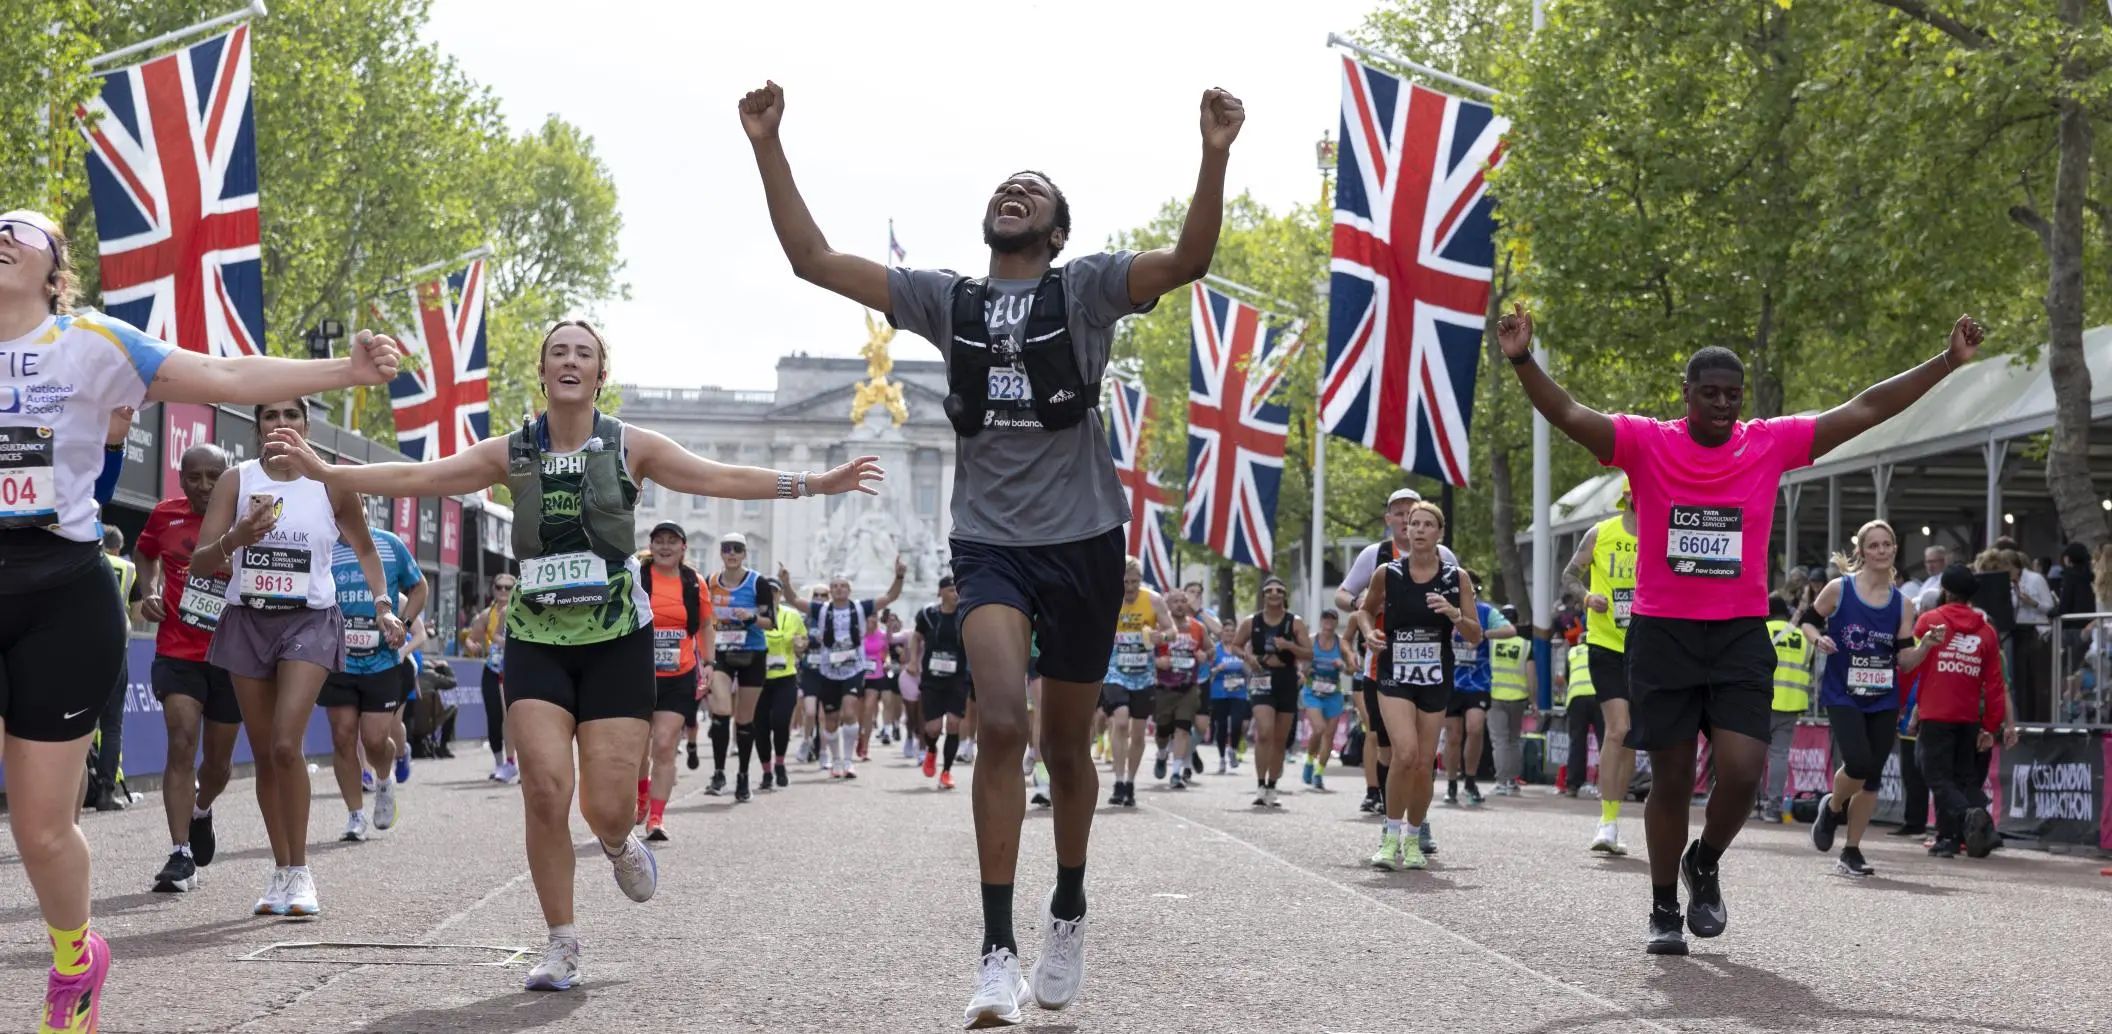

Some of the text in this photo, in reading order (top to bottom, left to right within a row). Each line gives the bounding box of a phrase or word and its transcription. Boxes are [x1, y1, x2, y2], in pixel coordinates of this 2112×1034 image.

[25, 384, 73, 393] National
[26, 394, 69, 403] Autistic
[26, 404, 65, 415] Society
[994, 419, 1011, 427] new
[1674, 508, 1700, 526] tcs
[293, 531, 309, 543] UK
[1679, 536, 1730, 555] 66047
[246, 549, 270, 566] tcs
[1709, 567, 1735, 575] balance
[255, 575, 293, 593] 9613
[189, 594, 222, 615] 7569
[572, 595, 603, 603] balance
[1400, 646, 1434, 660] 61145
[1852, 655, 1869, 667] tcs
[2049, 763, 2092, 791] LONDON
